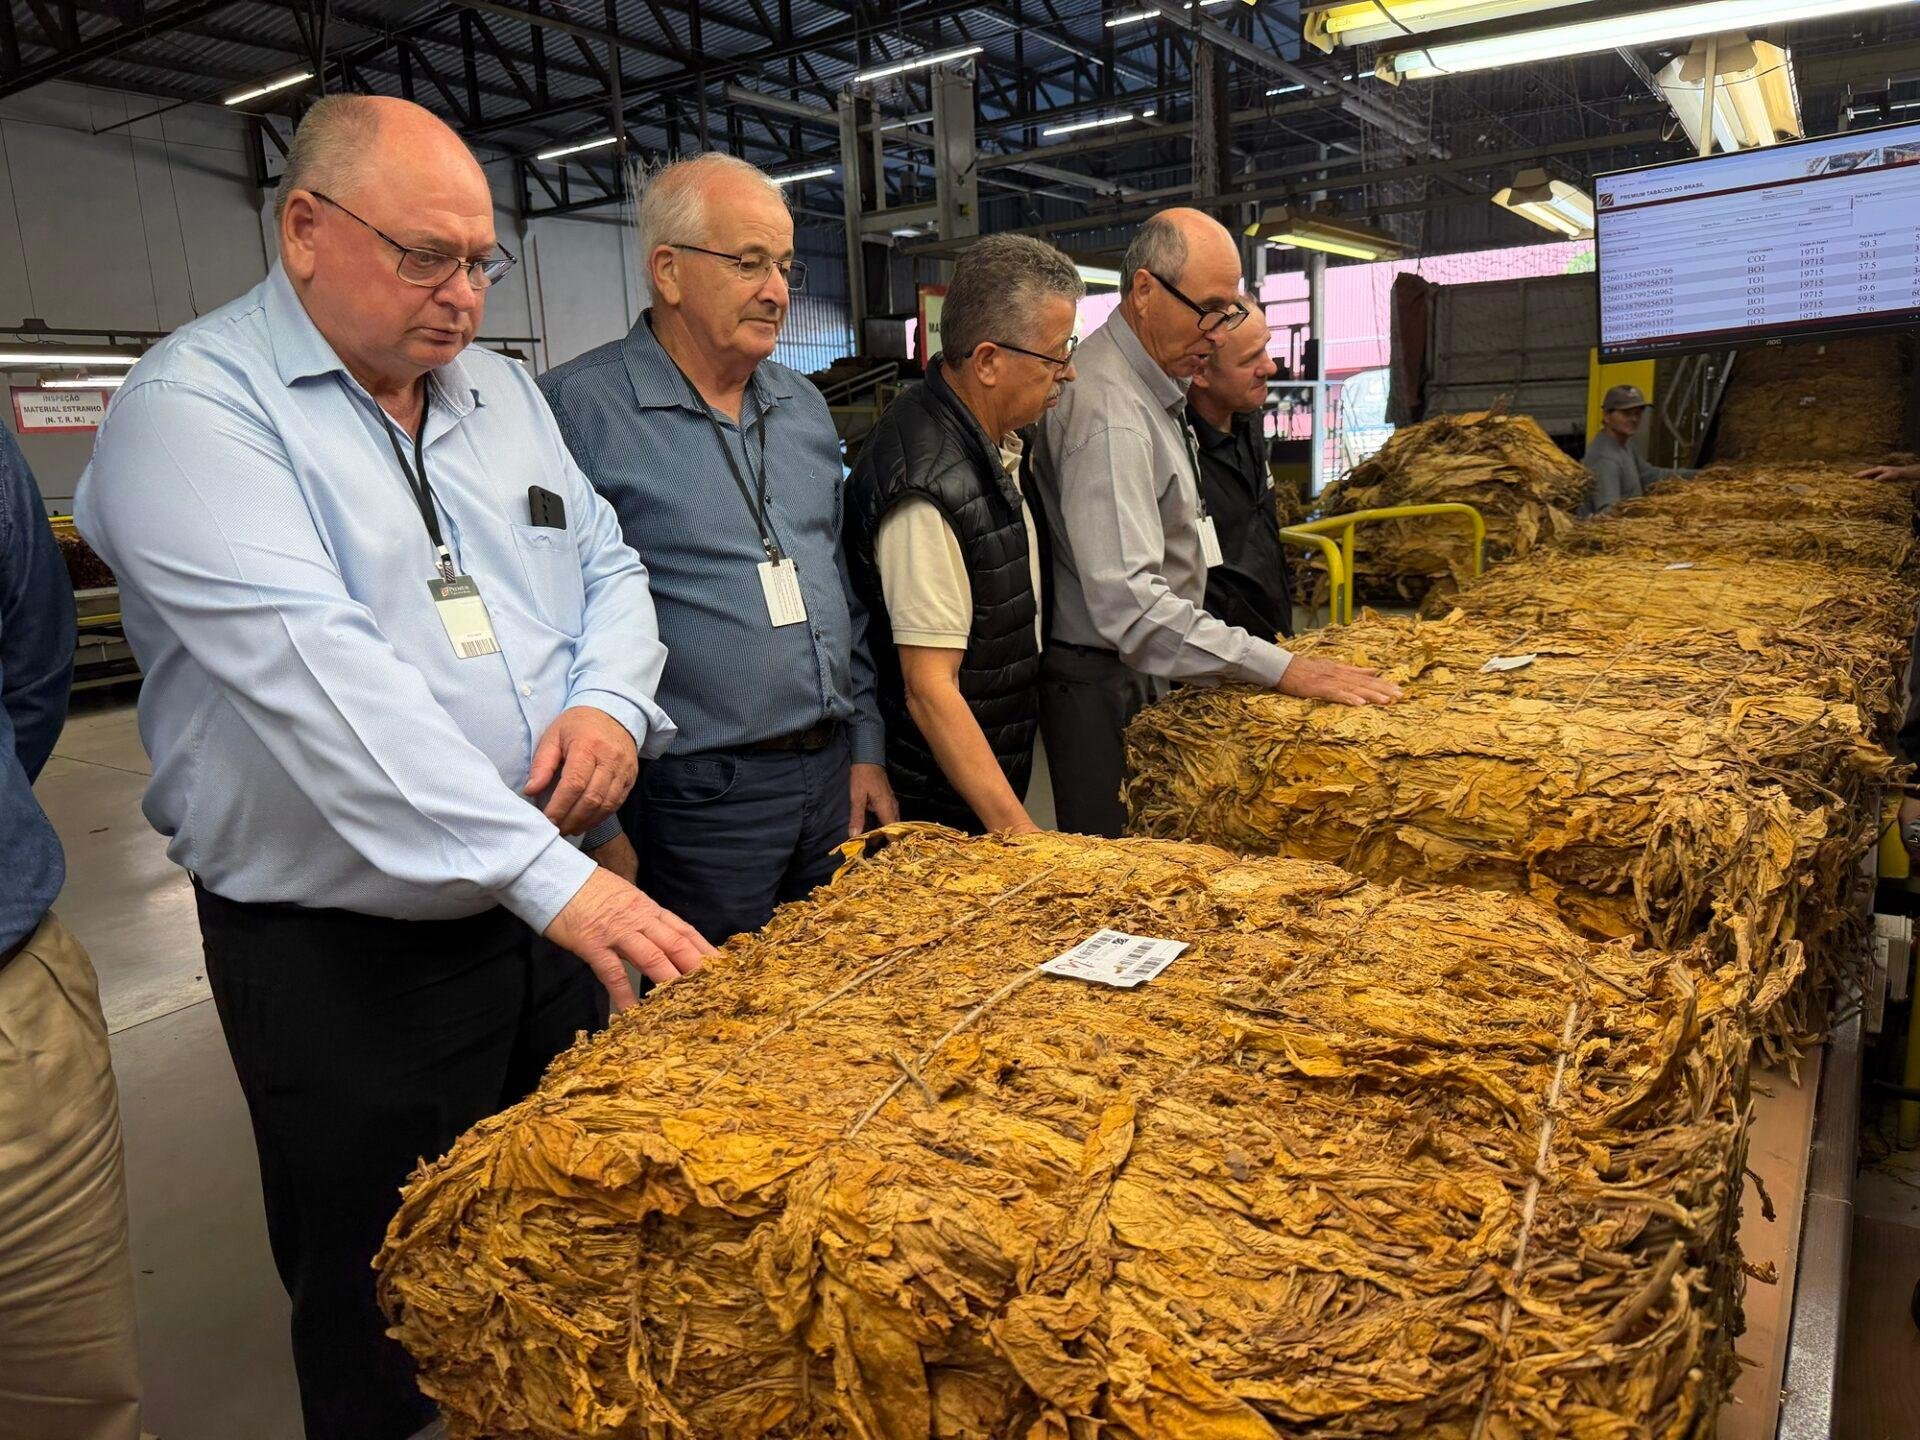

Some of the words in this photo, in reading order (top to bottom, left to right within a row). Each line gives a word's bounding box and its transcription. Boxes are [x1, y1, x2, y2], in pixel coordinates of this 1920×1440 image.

[1620, 192, 1646, 200] PREMIUM
[1647, 187, 1673, 196] TABACOS
[1684, 182, 1704, 190] BRASIL
[1800, 247, 1825, 256] 19715
[1859, 240, 1877, 248] 50.3
[1800, 258, 1824, 267] 19715
[1859, 251, 1876, 259] 33.1
[1800, 268, 1824, 278] 19715
[1859, 262, 1876, 270] 37.5
[1800, 279, 1824, 289] 19715
[1858, 273, 1876, 281] 34.7
[1800, 290, 1824, 299] 19715
[1800, 301, 1824, 310] 19715
[1858, 295, 1875, 303] 59.8
[1800, 311, 1823, 319] 19715
[43, 394, 80, 403] INSPEÇÃO
[45, 416, 56, 424] (N.
[74, 416, 86, 424] M.)
